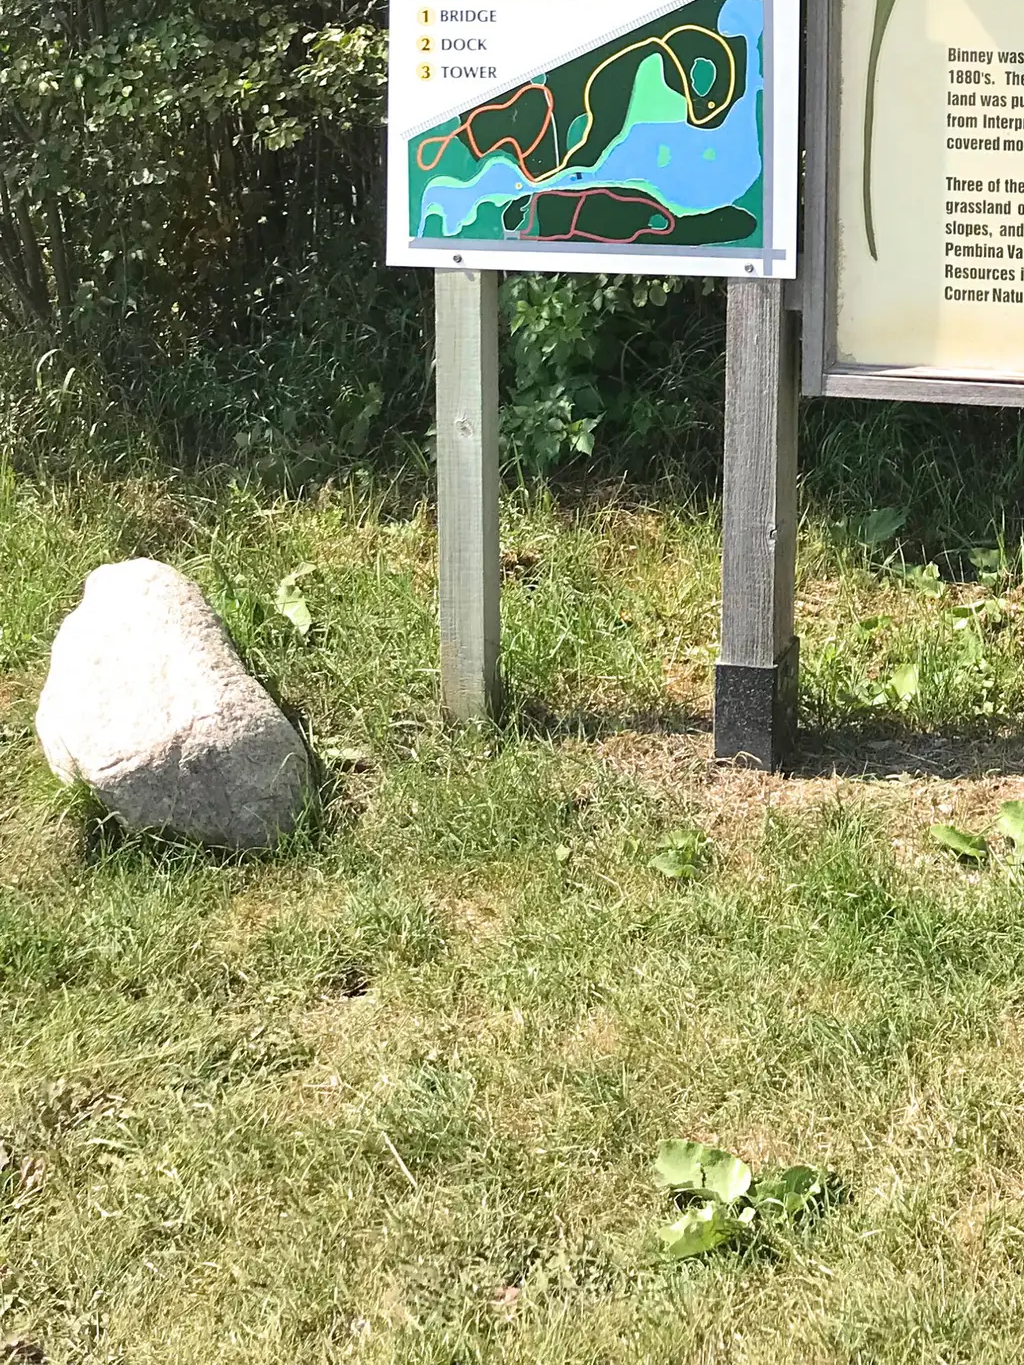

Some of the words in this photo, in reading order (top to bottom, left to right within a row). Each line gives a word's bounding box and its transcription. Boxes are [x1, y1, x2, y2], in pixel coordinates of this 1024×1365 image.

[422, 10, 429, 23] 1
[440, 9, 497, 23] BRIDGE
[421, 38, 431, 51] 2
[441, 38, 488, 51] DOCK
[947, 47, 993, 65] Binney
[996, 51, 1024, 65] was
[421, 66, 431, 79] 3
[440, 66, 497, 79] TOWER
[947, 69, 995, 85] 1880's.
[946, 91, 976, 107] land
[979, 95, 1007, 108] was
[944, 176, 983, 192] Three
[987, 178, 1001, 193] of
[944, 199, 1011, 215] grassland
[944, 220, 993, 238] slopes,
[998, 223, 1024, 238] and
[944, 242, 1004, 259] Pembina
[944, 264, 1015, 281] Resources
[943, 285, 990, 302] Corner
